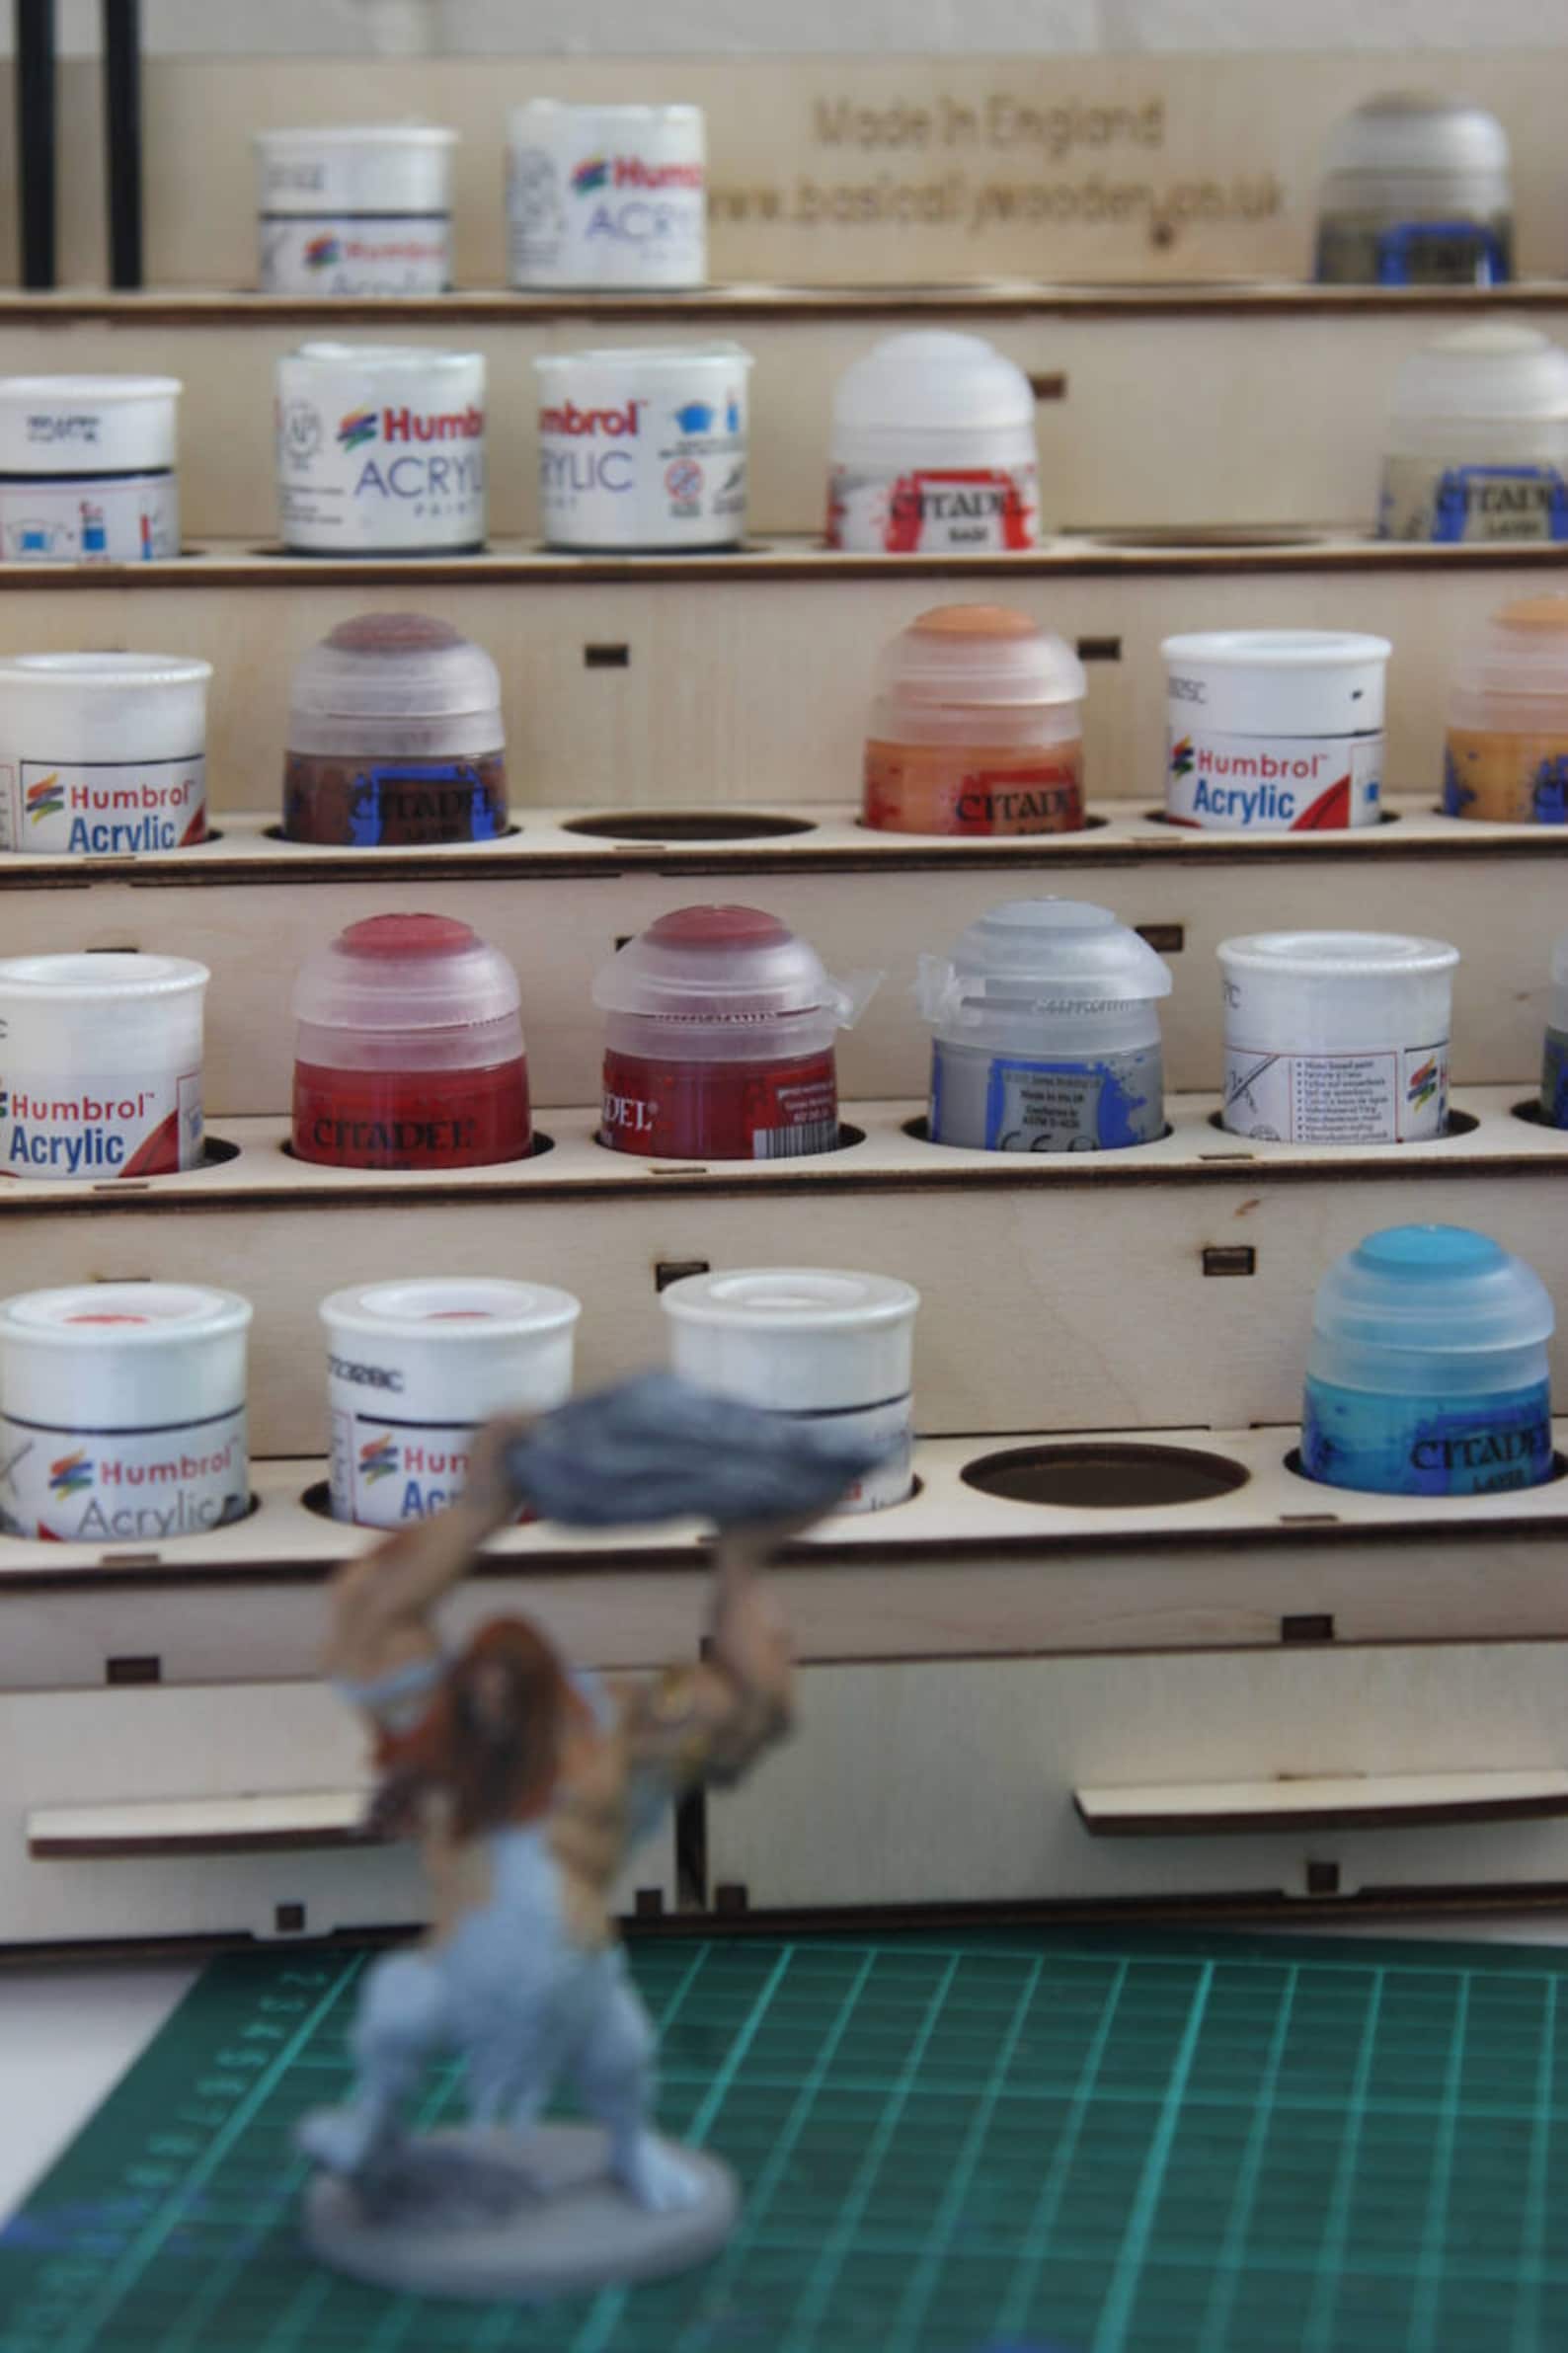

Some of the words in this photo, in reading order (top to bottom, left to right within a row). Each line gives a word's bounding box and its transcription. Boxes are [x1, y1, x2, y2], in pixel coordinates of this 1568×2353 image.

[812, 96, 929, 150] Made
[987, 96, 1164, 165] England
[1197, 749, 1319, 779] Humbrol
[70, 783, 190, 811] Humbrol
[1193, 780, 1295, 825] Acrylic
[68, 815, 176, 854] Acrylic
[12, 1091, 146, 1123] Humbrol
[9, 1126, 125, 1174] Acrylic
[101, 1446, 232, 1485] Humbrol
[78, 1489, 215, 1538] Acrylic
